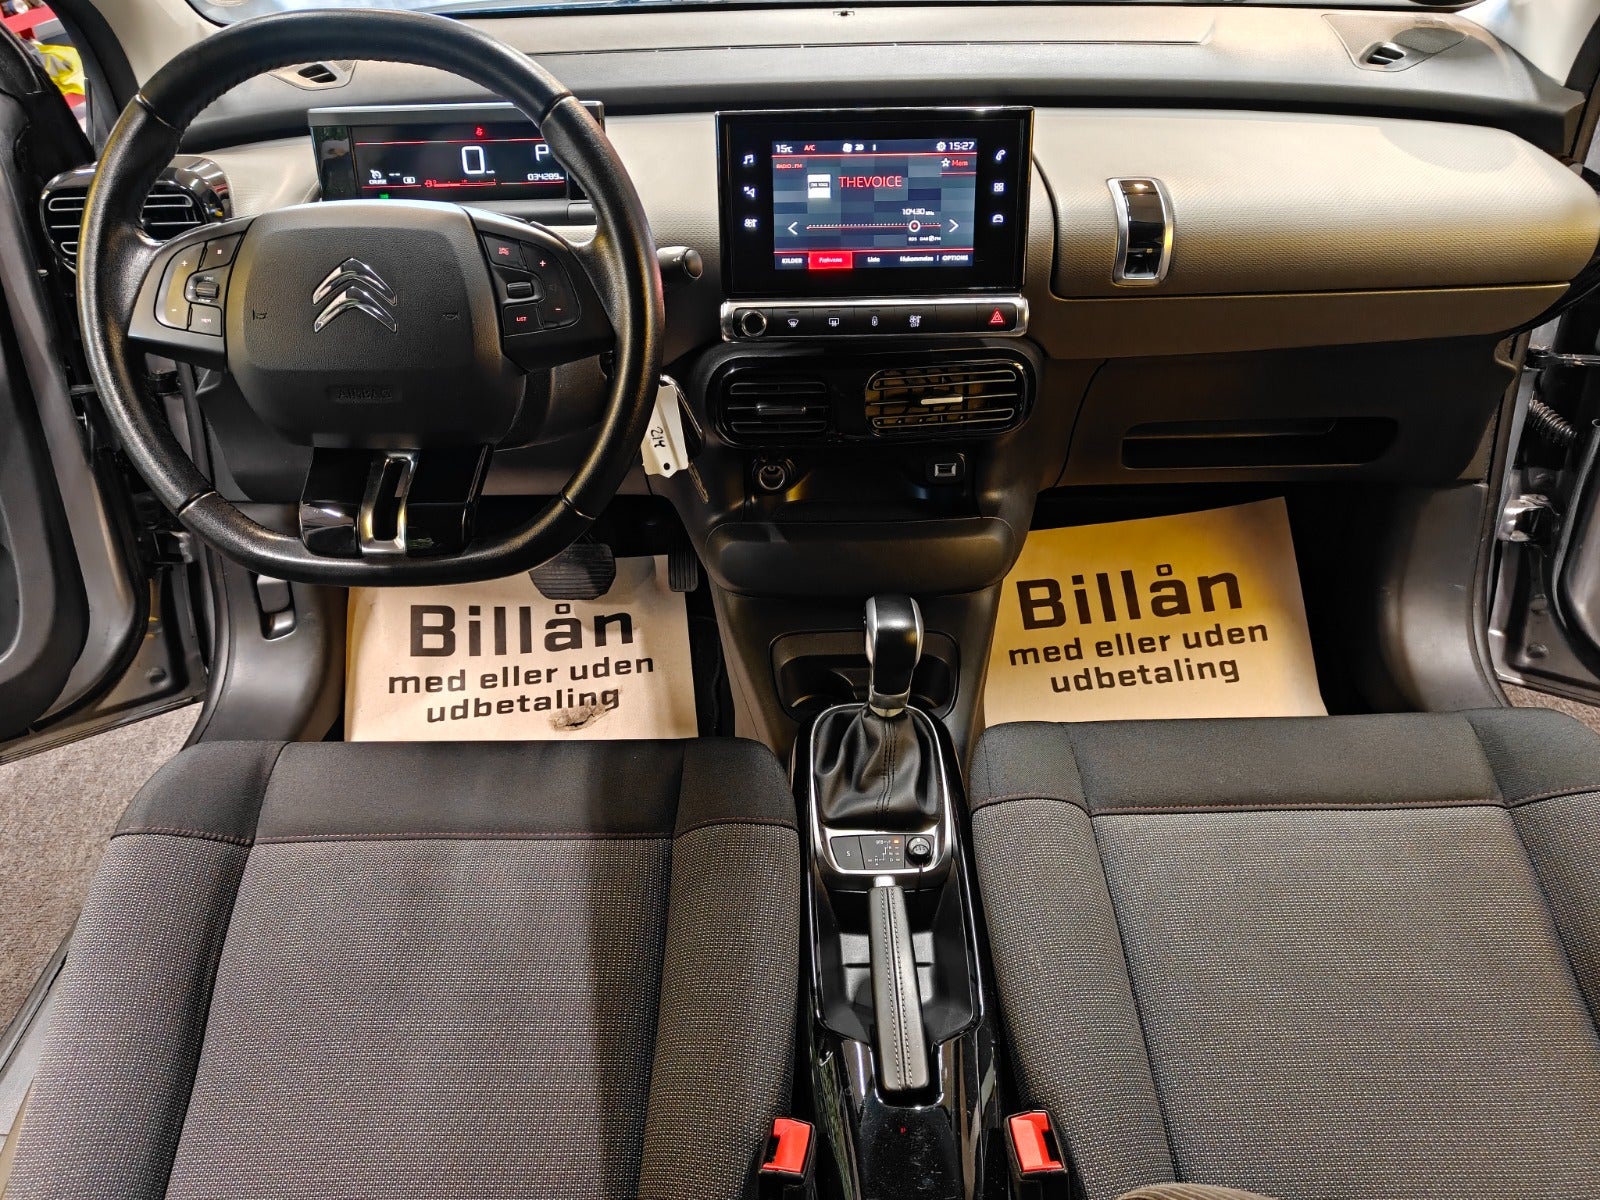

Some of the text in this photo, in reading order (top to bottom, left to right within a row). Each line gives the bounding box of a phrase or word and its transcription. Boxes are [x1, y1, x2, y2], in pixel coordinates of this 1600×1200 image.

[461, 145, 486, 175] 0
[534, 144, 550, 162] P
[949, 142, 975, 150] 15:27
[951, 159, 969, 167] Mem
[838, 175, 902, 188] THEVOICE
[1015, 563, 1243, 631] Billån
[409, 603, 634, 657] Billån
[1008, 623, 1268, 667] med eller uden
[388, 656, 655, 694] med eller uden
[1050, 657, 1240, 694] udbetaling
[427, 687, 620, 724] udbetaling
